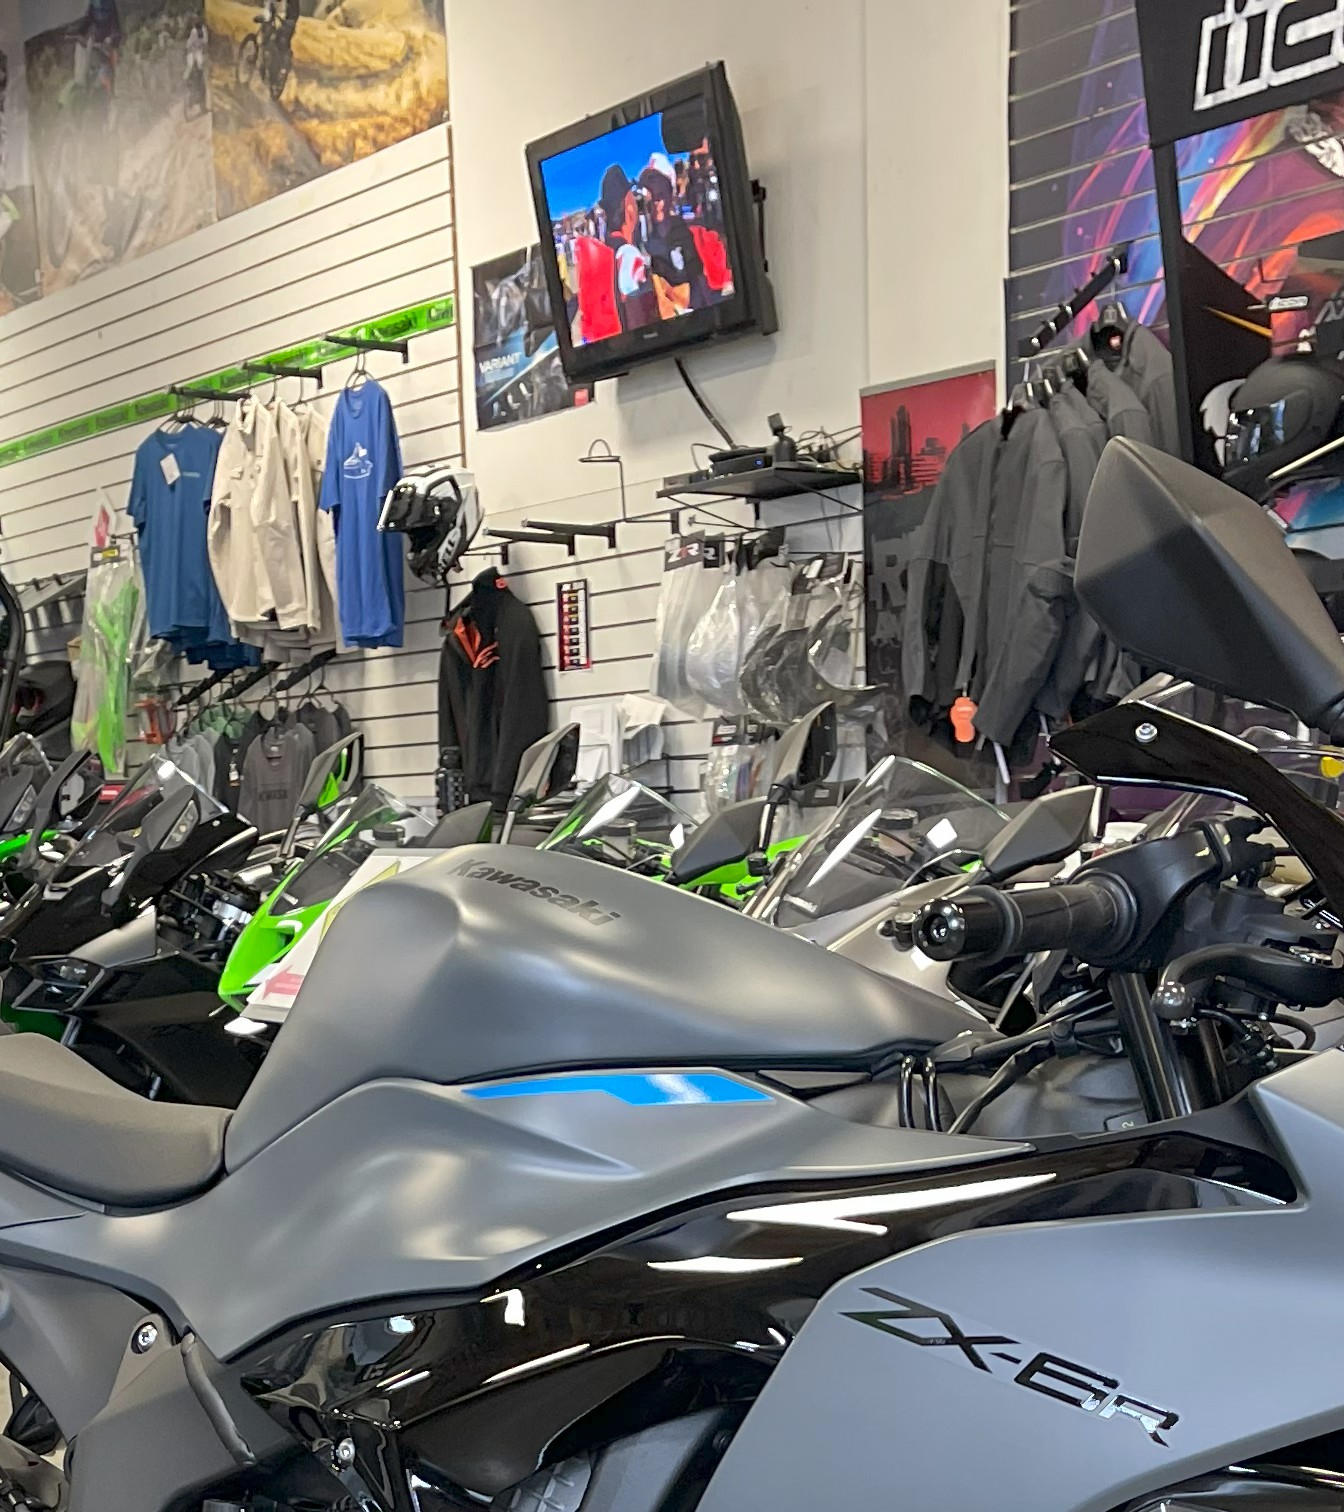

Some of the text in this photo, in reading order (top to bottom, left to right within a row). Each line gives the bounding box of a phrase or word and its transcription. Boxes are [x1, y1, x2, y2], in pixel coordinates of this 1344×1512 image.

[478, 351, 523, 374] VARIANT
[447, 858, 622, 927] Kawasaki
[838, 1286, 1180, 1449] ZX-6R
